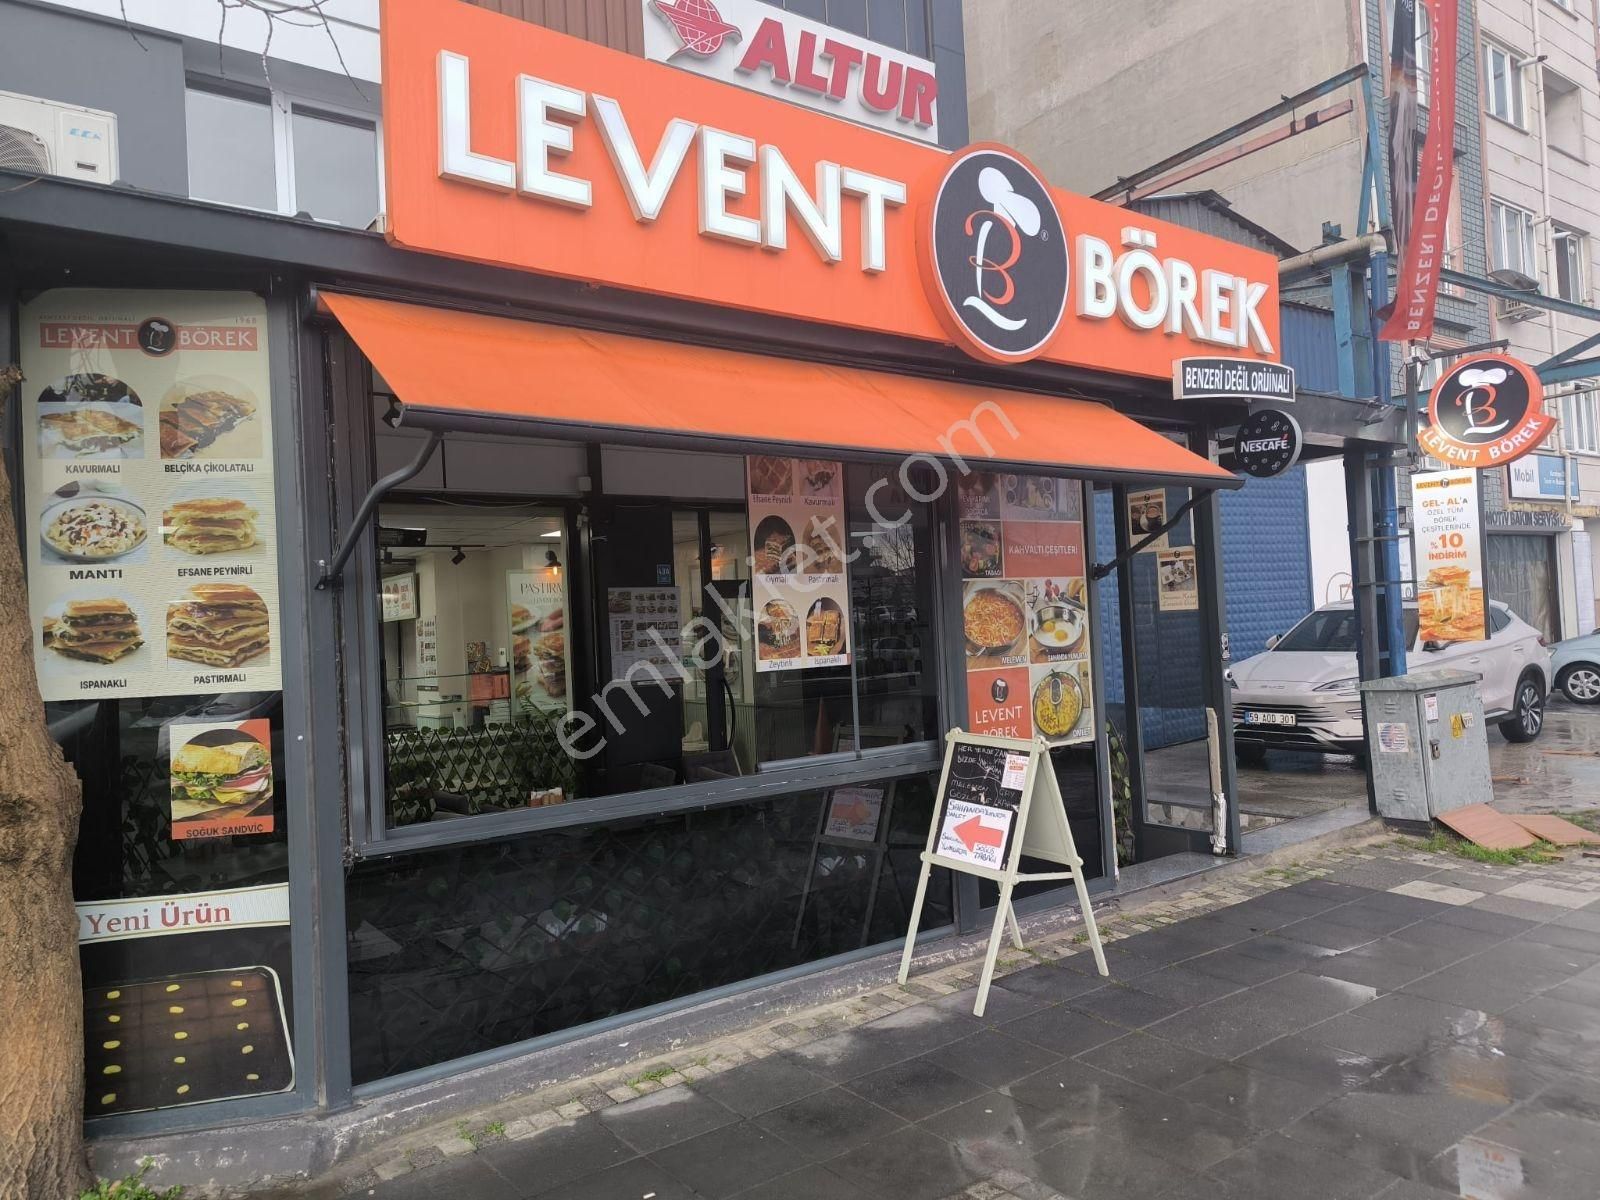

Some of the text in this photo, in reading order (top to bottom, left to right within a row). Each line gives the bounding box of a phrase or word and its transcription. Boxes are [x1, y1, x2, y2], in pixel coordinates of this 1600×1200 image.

[734, 16, 937, 129] ALTUR
[436, 48, 907, 274] LEVENT
[1075, 225, 1275, 355] BÖREK
[44, 327, 253, 346] LEVENT BÖREK
[1185, 364, 1290, 393] BENZERİ DEĞİL ORİJİNALİ
[1423, 418, 1542, 462] LEVENT BÖREK
[65, 464, 121, 474] KAVURMALI
[164, 462, 255, 474] BELÇİKA ÇİKOLATALI
[1514, 468, 1535, 482] Mobil
[69, 569, 123, 580] MANTI
[177, 565, 253, 577] EFSANE PEYNİRLİ
[80, 679, 127, 690] ISPANAKLI
[193, 674, 247, 685] PASTIRMALI
[975, 705, 1023, 724] LEVENT
[1249, 712, 1259, 722] 59
[1280, 714, 1294, 724] 301
[186, 826, 220, 838] SOĞUK
[85, 901, 231, 935] Yeni Ürün
